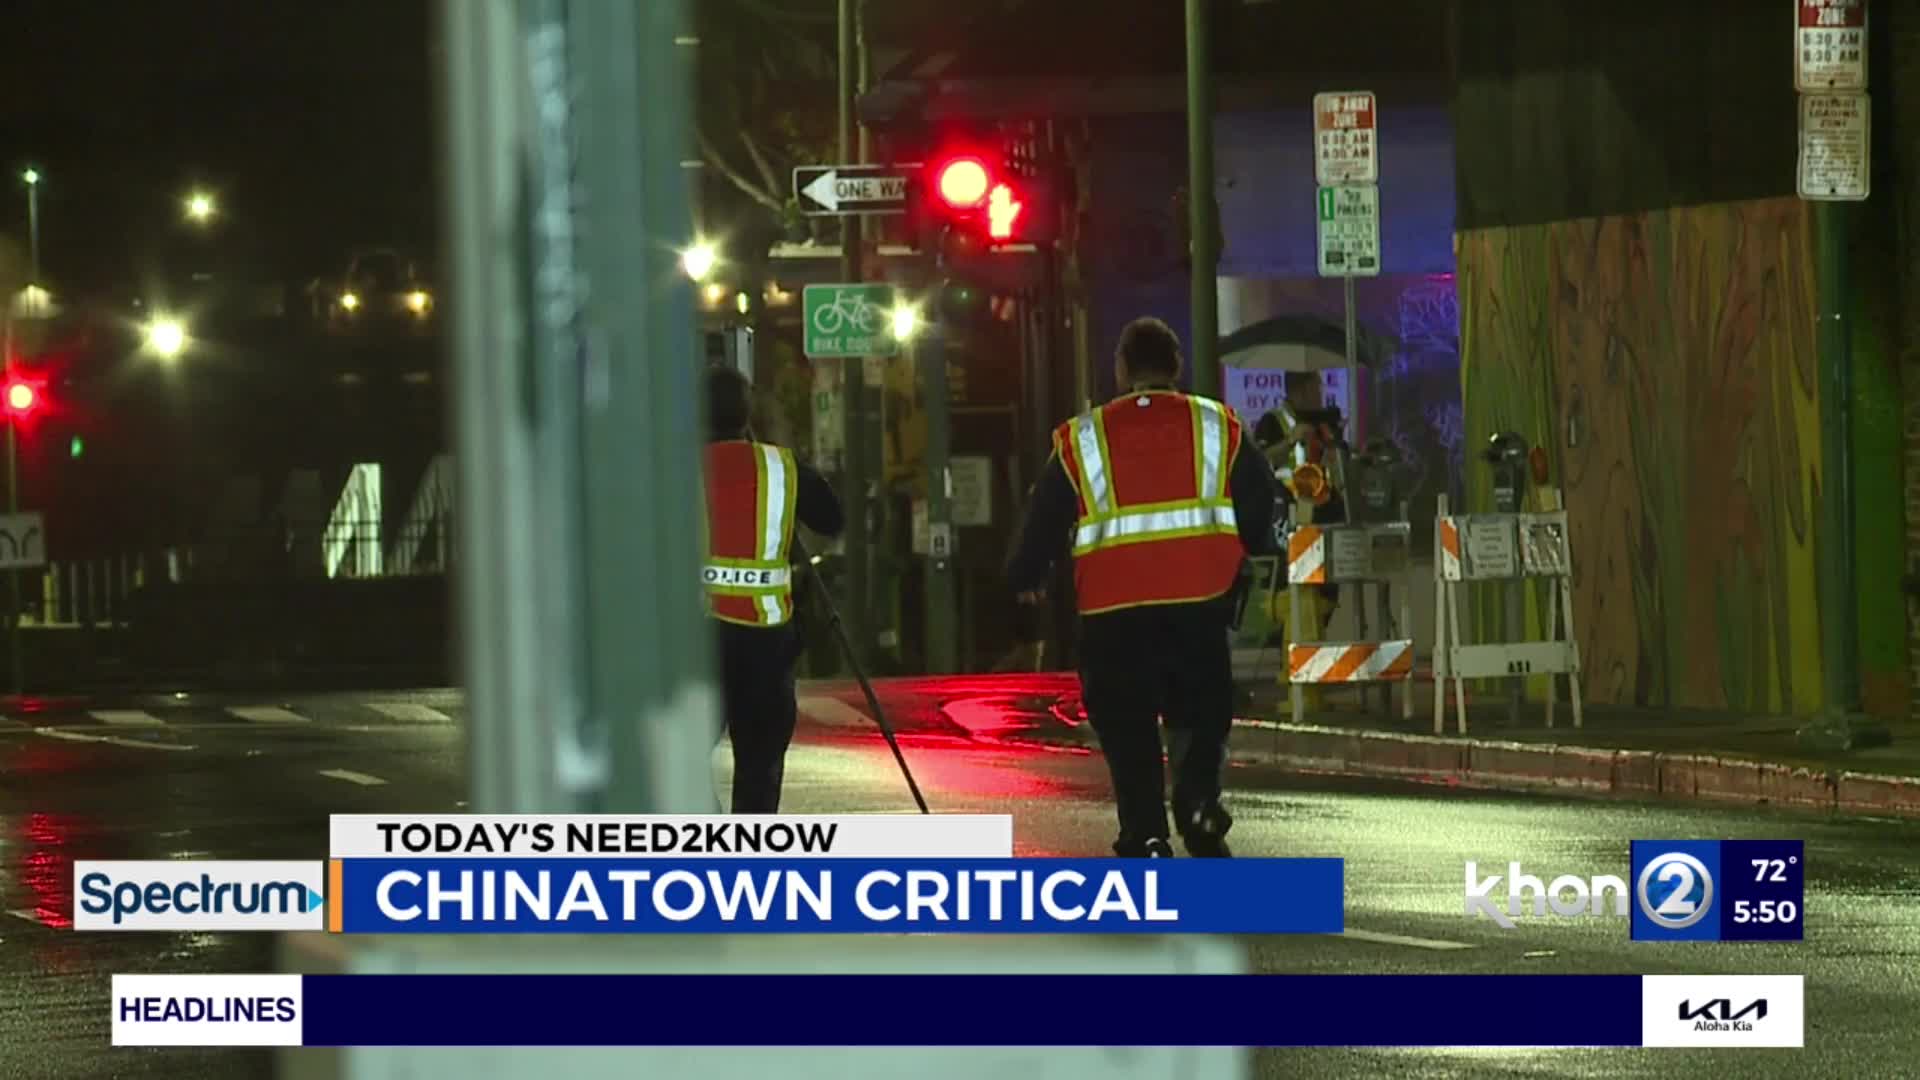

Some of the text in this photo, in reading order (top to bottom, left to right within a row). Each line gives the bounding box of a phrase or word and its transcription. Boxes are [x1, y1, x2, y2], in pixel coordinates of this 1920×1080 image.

[1839, 32, 1859, 45] AM
[1838, 50, 1859, 62] AM
[1353, 134, 1369, 145] AM
[1353, 148, 1370, 158] AM
[836, 181, 906, 198] ONE WA
[813, 337, 841, 352] BIKE
[704, 569, 771, 584] OLICE
